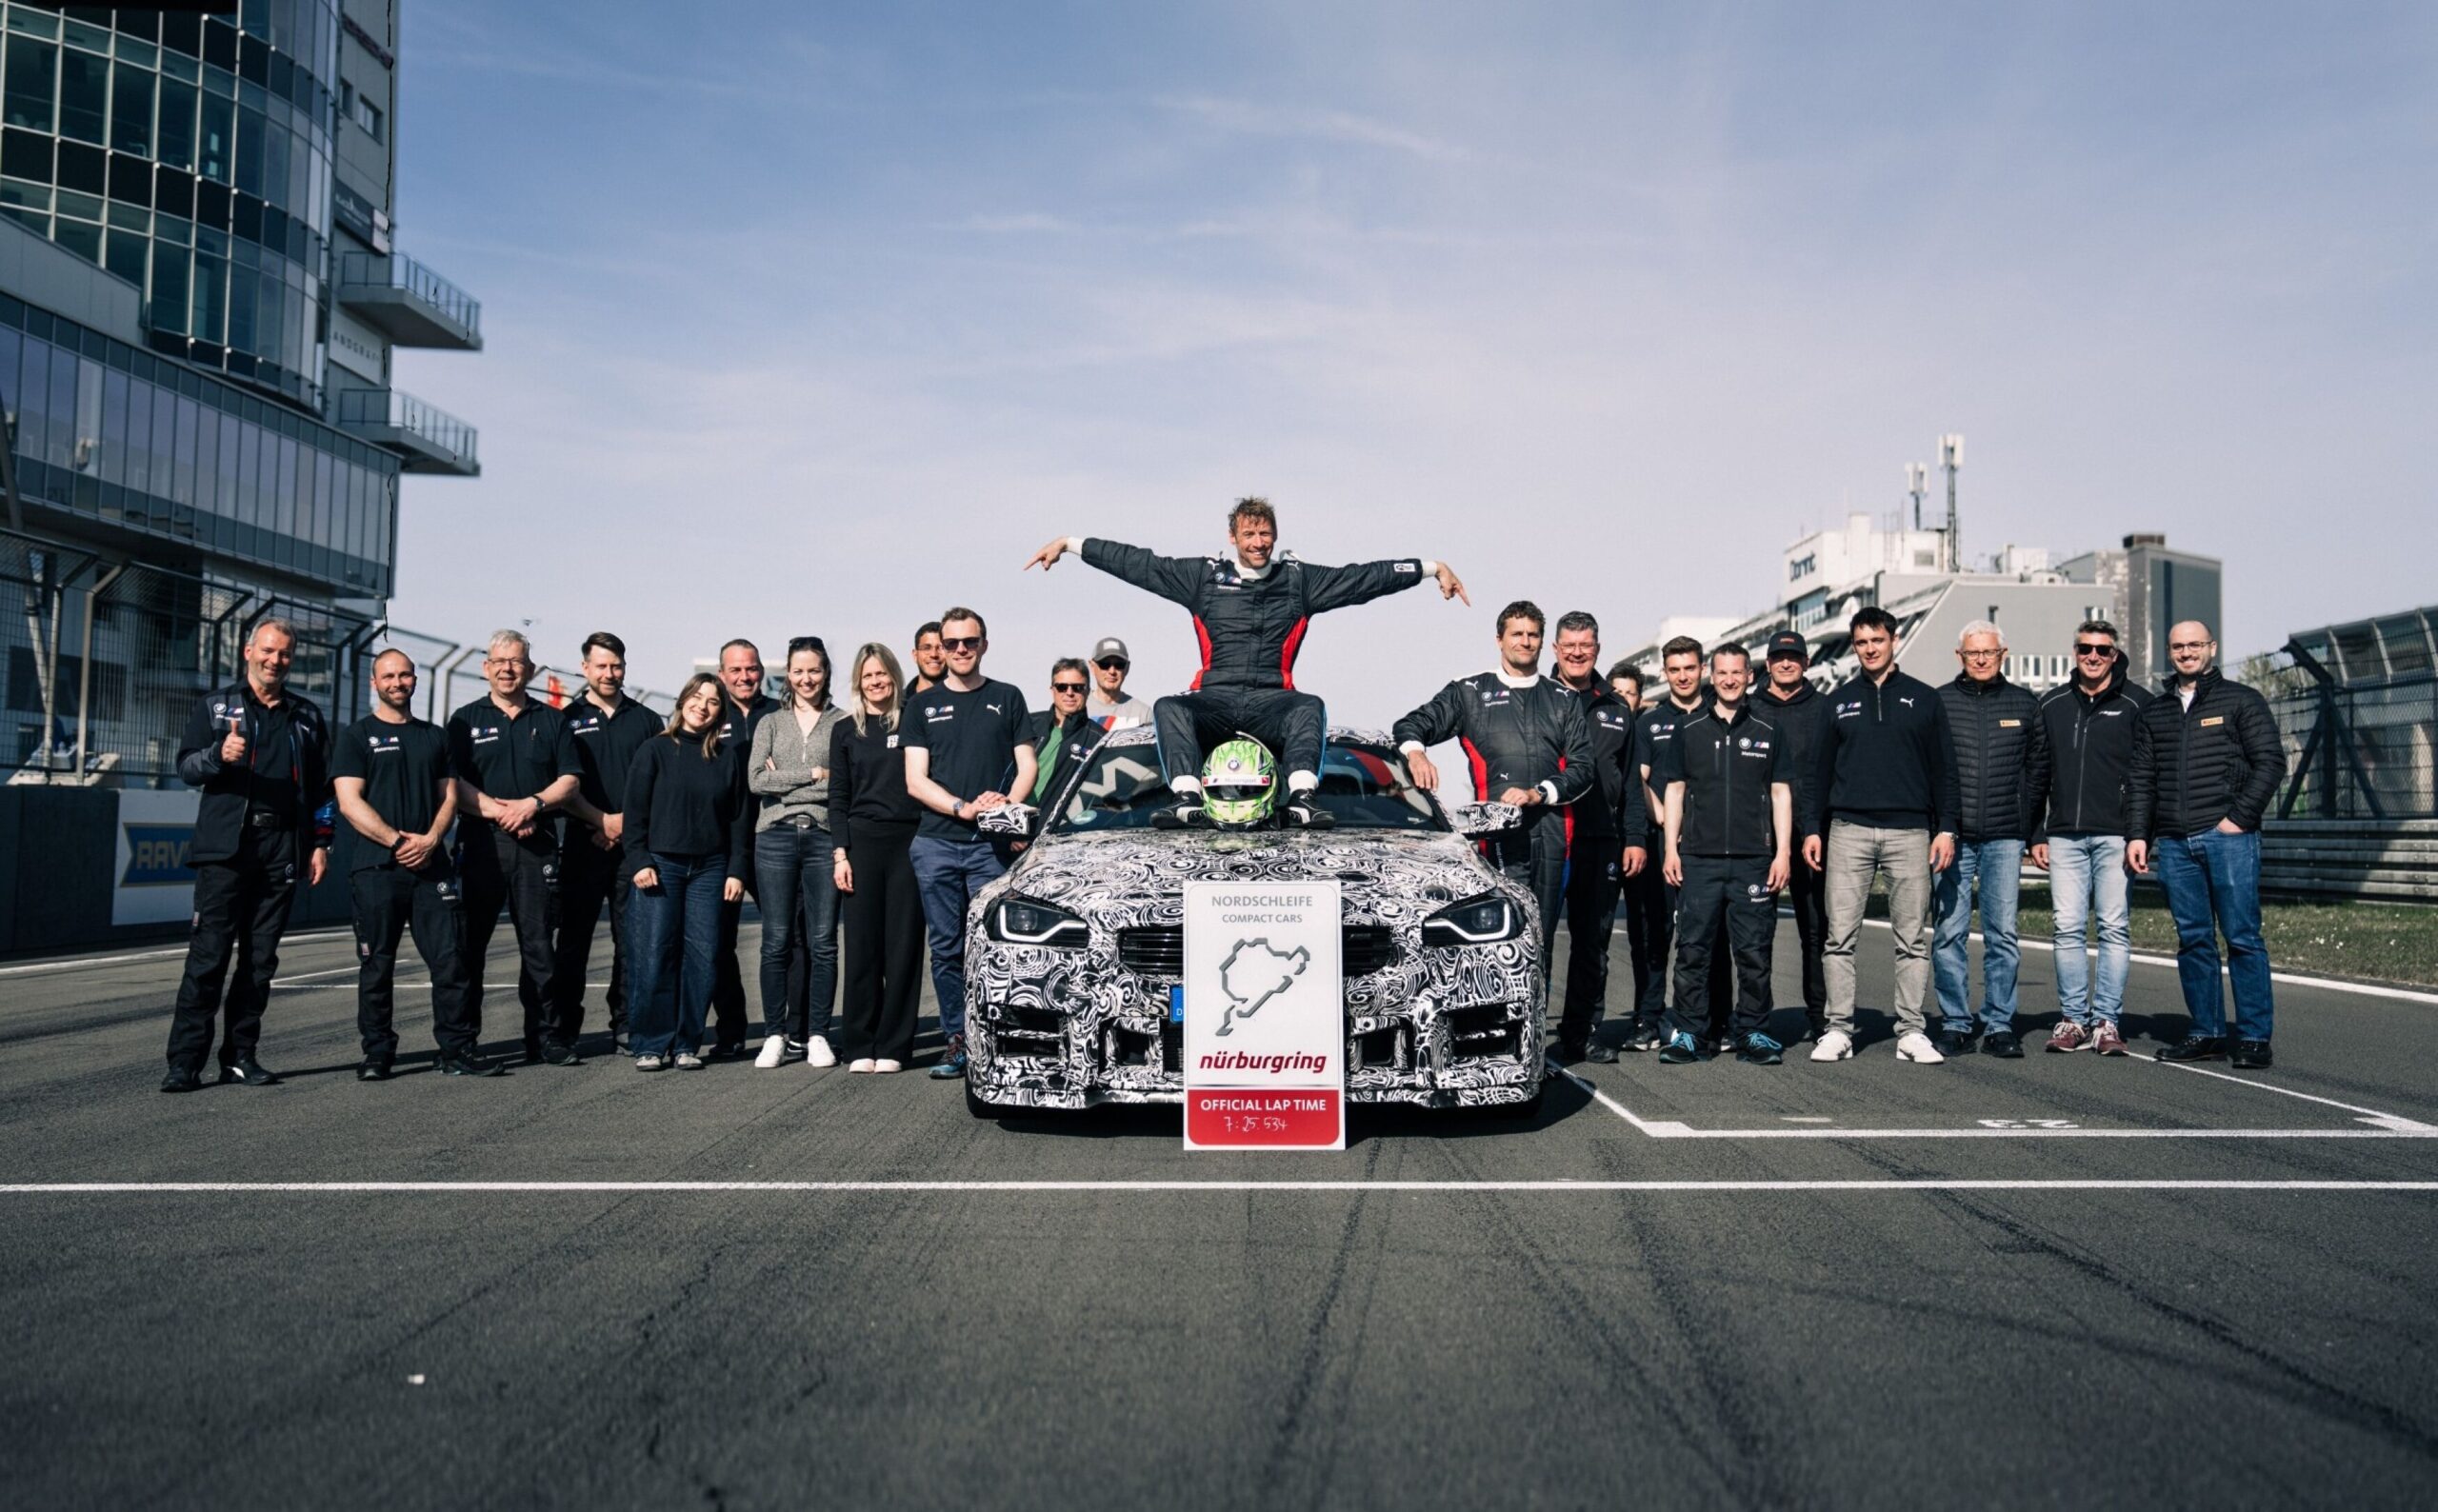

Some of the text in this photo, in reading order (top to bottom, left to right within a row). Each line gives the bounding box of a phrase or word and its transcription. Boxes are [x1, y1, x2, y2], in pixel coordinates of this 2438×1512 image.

[137, 841, 191, 869] RAV
[1211, 895, 1313, 907] NORDSCHLEIFE
[1222, 913, 1303, 924] COMPACT CARS
[1199, 1050, 1328, 1074] nürburgring
[1200, 1099, 1327, 1112] OFFICIAL LAP TIME
